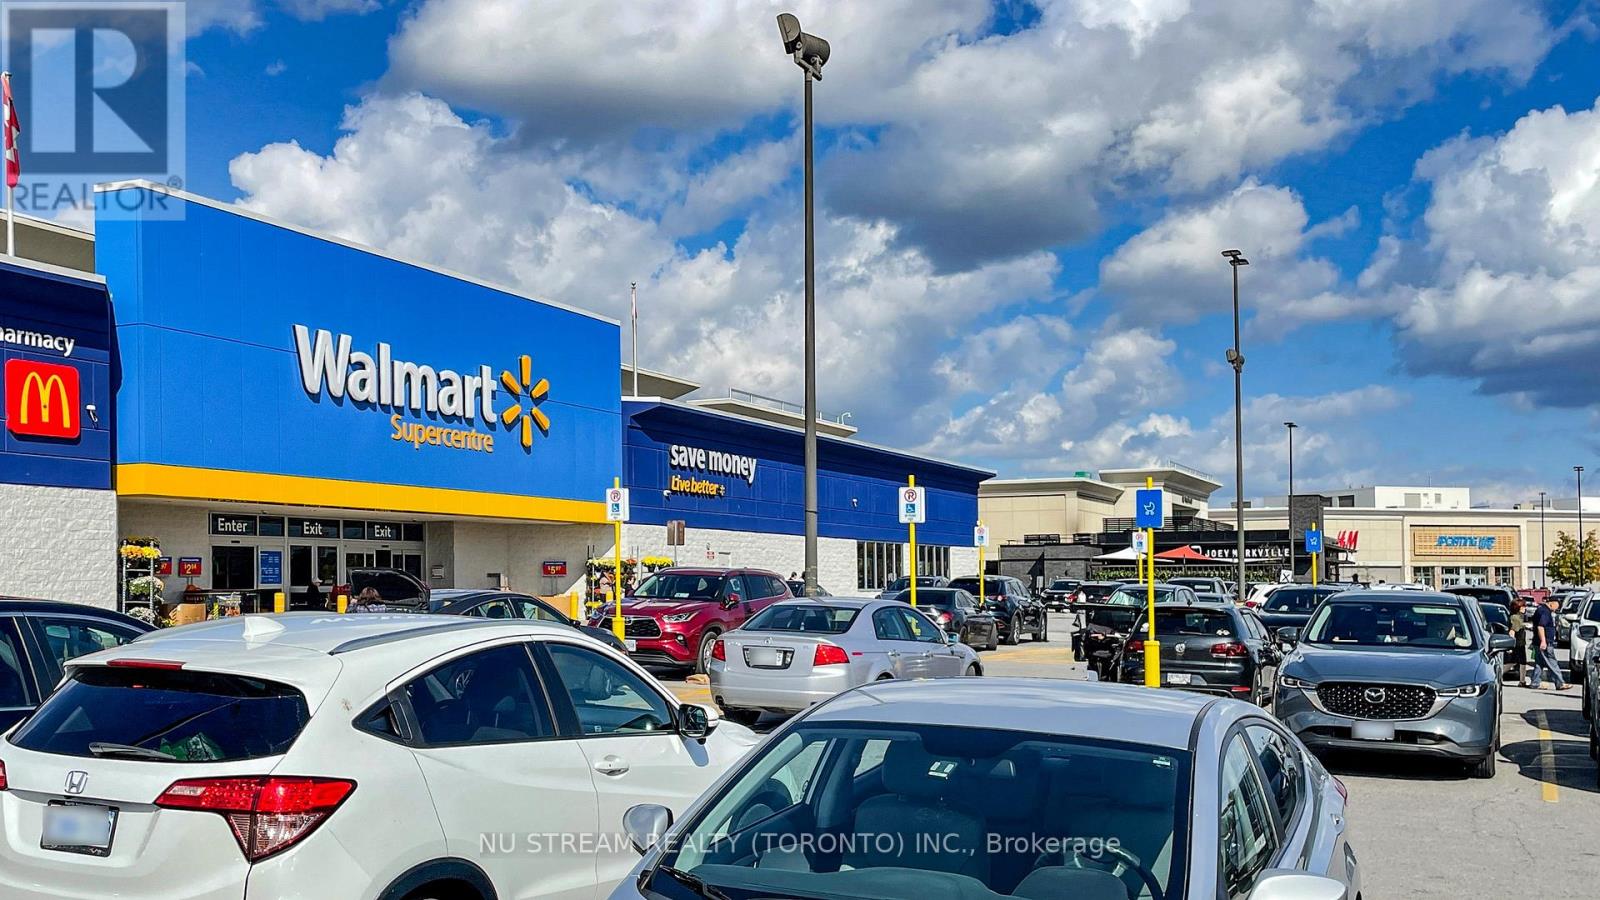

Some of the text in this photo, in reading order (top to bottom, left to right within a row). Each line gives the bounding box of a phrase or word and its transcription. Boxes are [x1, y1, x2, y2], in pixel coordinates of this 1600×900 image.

[294, 324, 497, 423] Walmart
[390, 413, 494, 453] Supercentre
[671, 444, 757, 484] save money
[671, 474, 719, 495] Live better
[217, 517, 248, 533] Enter
[303, 521, 323, 536] Exit
[374, 525, 392, 538] Exit
[1205, 548, 1290, 558] JOEY MRKVILLE
